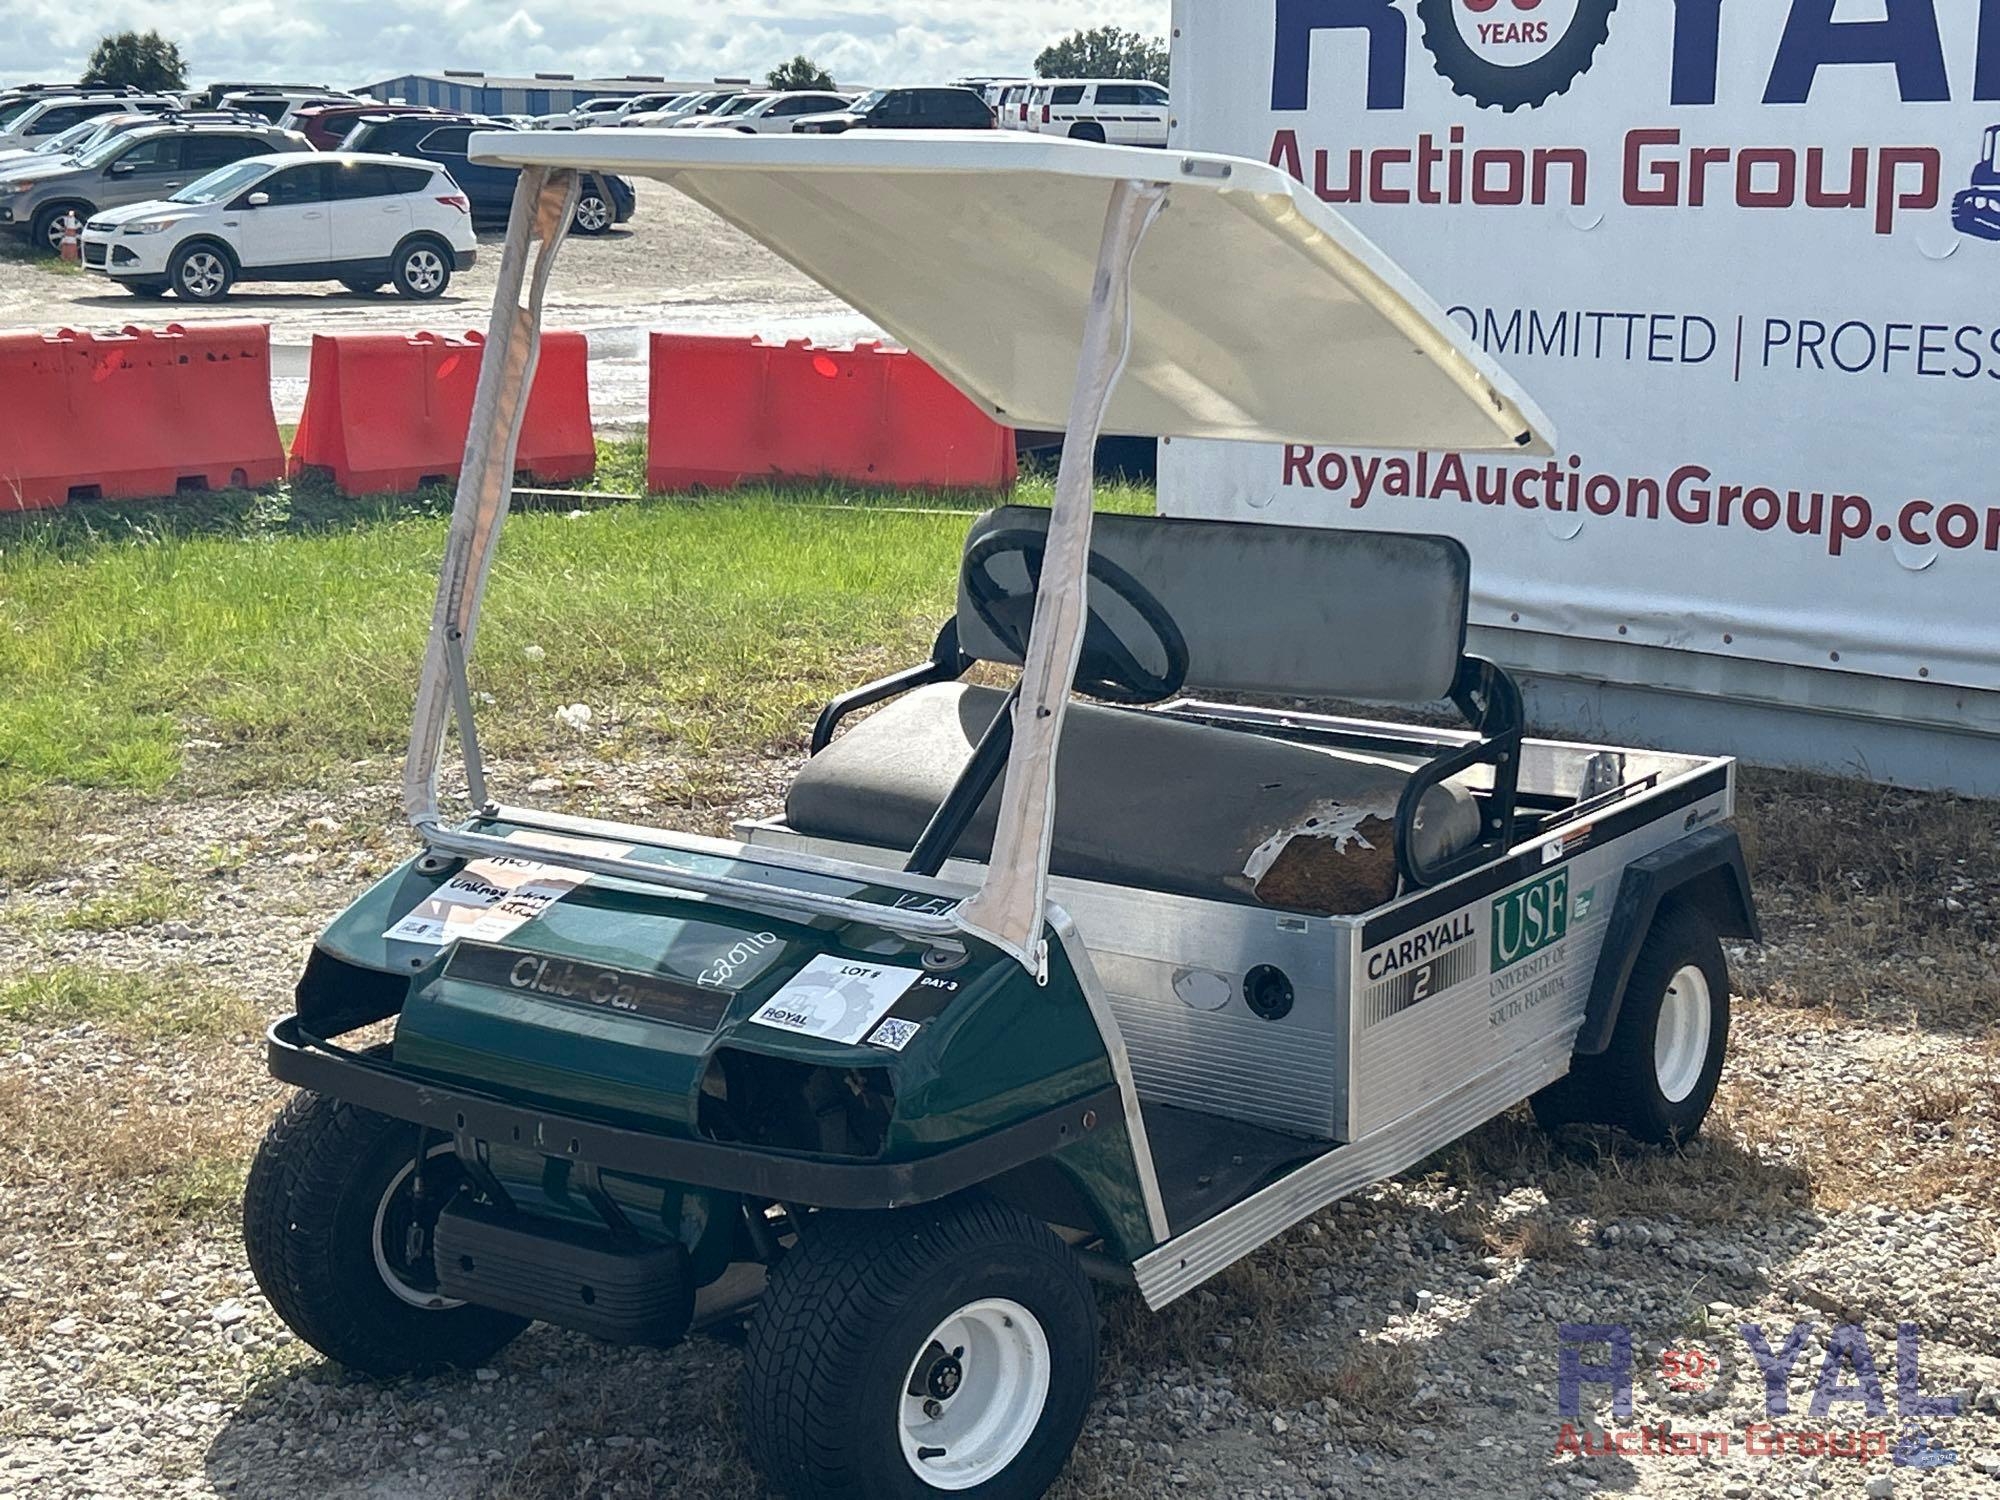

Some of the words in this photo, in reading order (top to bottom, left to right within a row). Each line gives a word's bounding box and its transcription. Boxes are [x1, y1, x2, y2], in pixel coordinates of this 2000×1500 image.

[1477, 22, 1549, 44] YEARS
[1269, 126, 1589, 205] Auction
[1624, 128, 1942, 235] Group
[1446, 306, 1717, 364] OMMITTED
[1493, 875, 1568, 963] USF
[840, 965, 871, 978] LOT
[870, 970, 884, 979] #
[1367, 912, 1475, 981] CARRYALL
[1488, 955, 1552, 998] UNIVERSITY
[1552, 943, 1568, 963] OF
[509, 955, 578, 997] Club
[589, 971, 640, 1010] Car
[920, 976, 947, 989] DAY
[946, 979, 959, 991] 3
[1412, 966, 1432, 999] 2
[1488, 998, 1523, 1029] SOUTH
[1523, 975, 1566, 1010] FLORIDA
[762, 1007, 809, 1026] ROYAL
